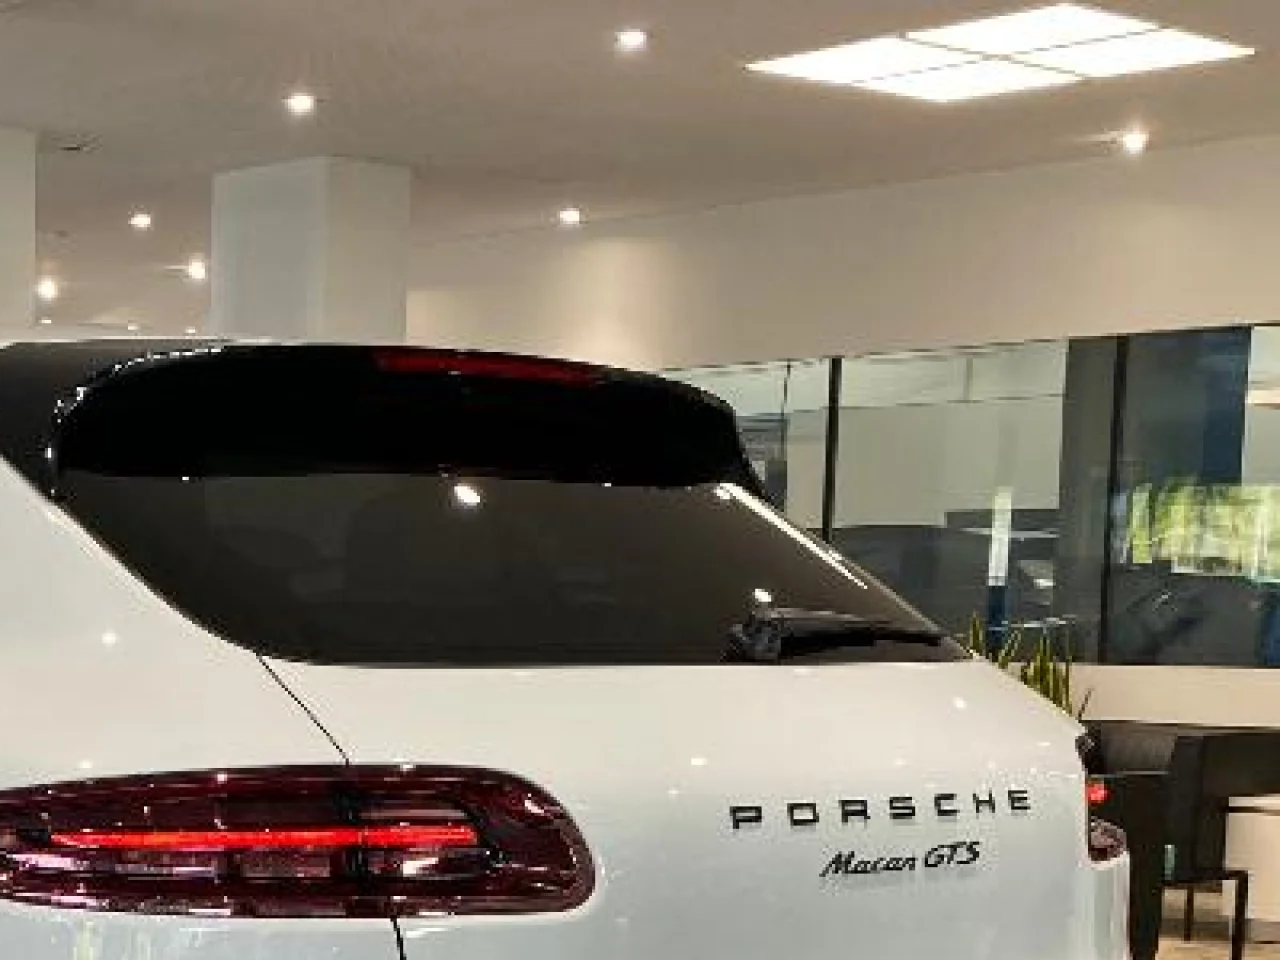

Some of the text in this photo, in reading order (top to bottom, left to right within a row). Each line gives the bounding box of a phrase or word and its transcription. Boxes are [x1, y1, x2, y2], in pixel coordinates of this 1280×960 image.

[729, 789, 1031, 830] PORSCHE
[819, 841, 980, 877] Macan GTS
